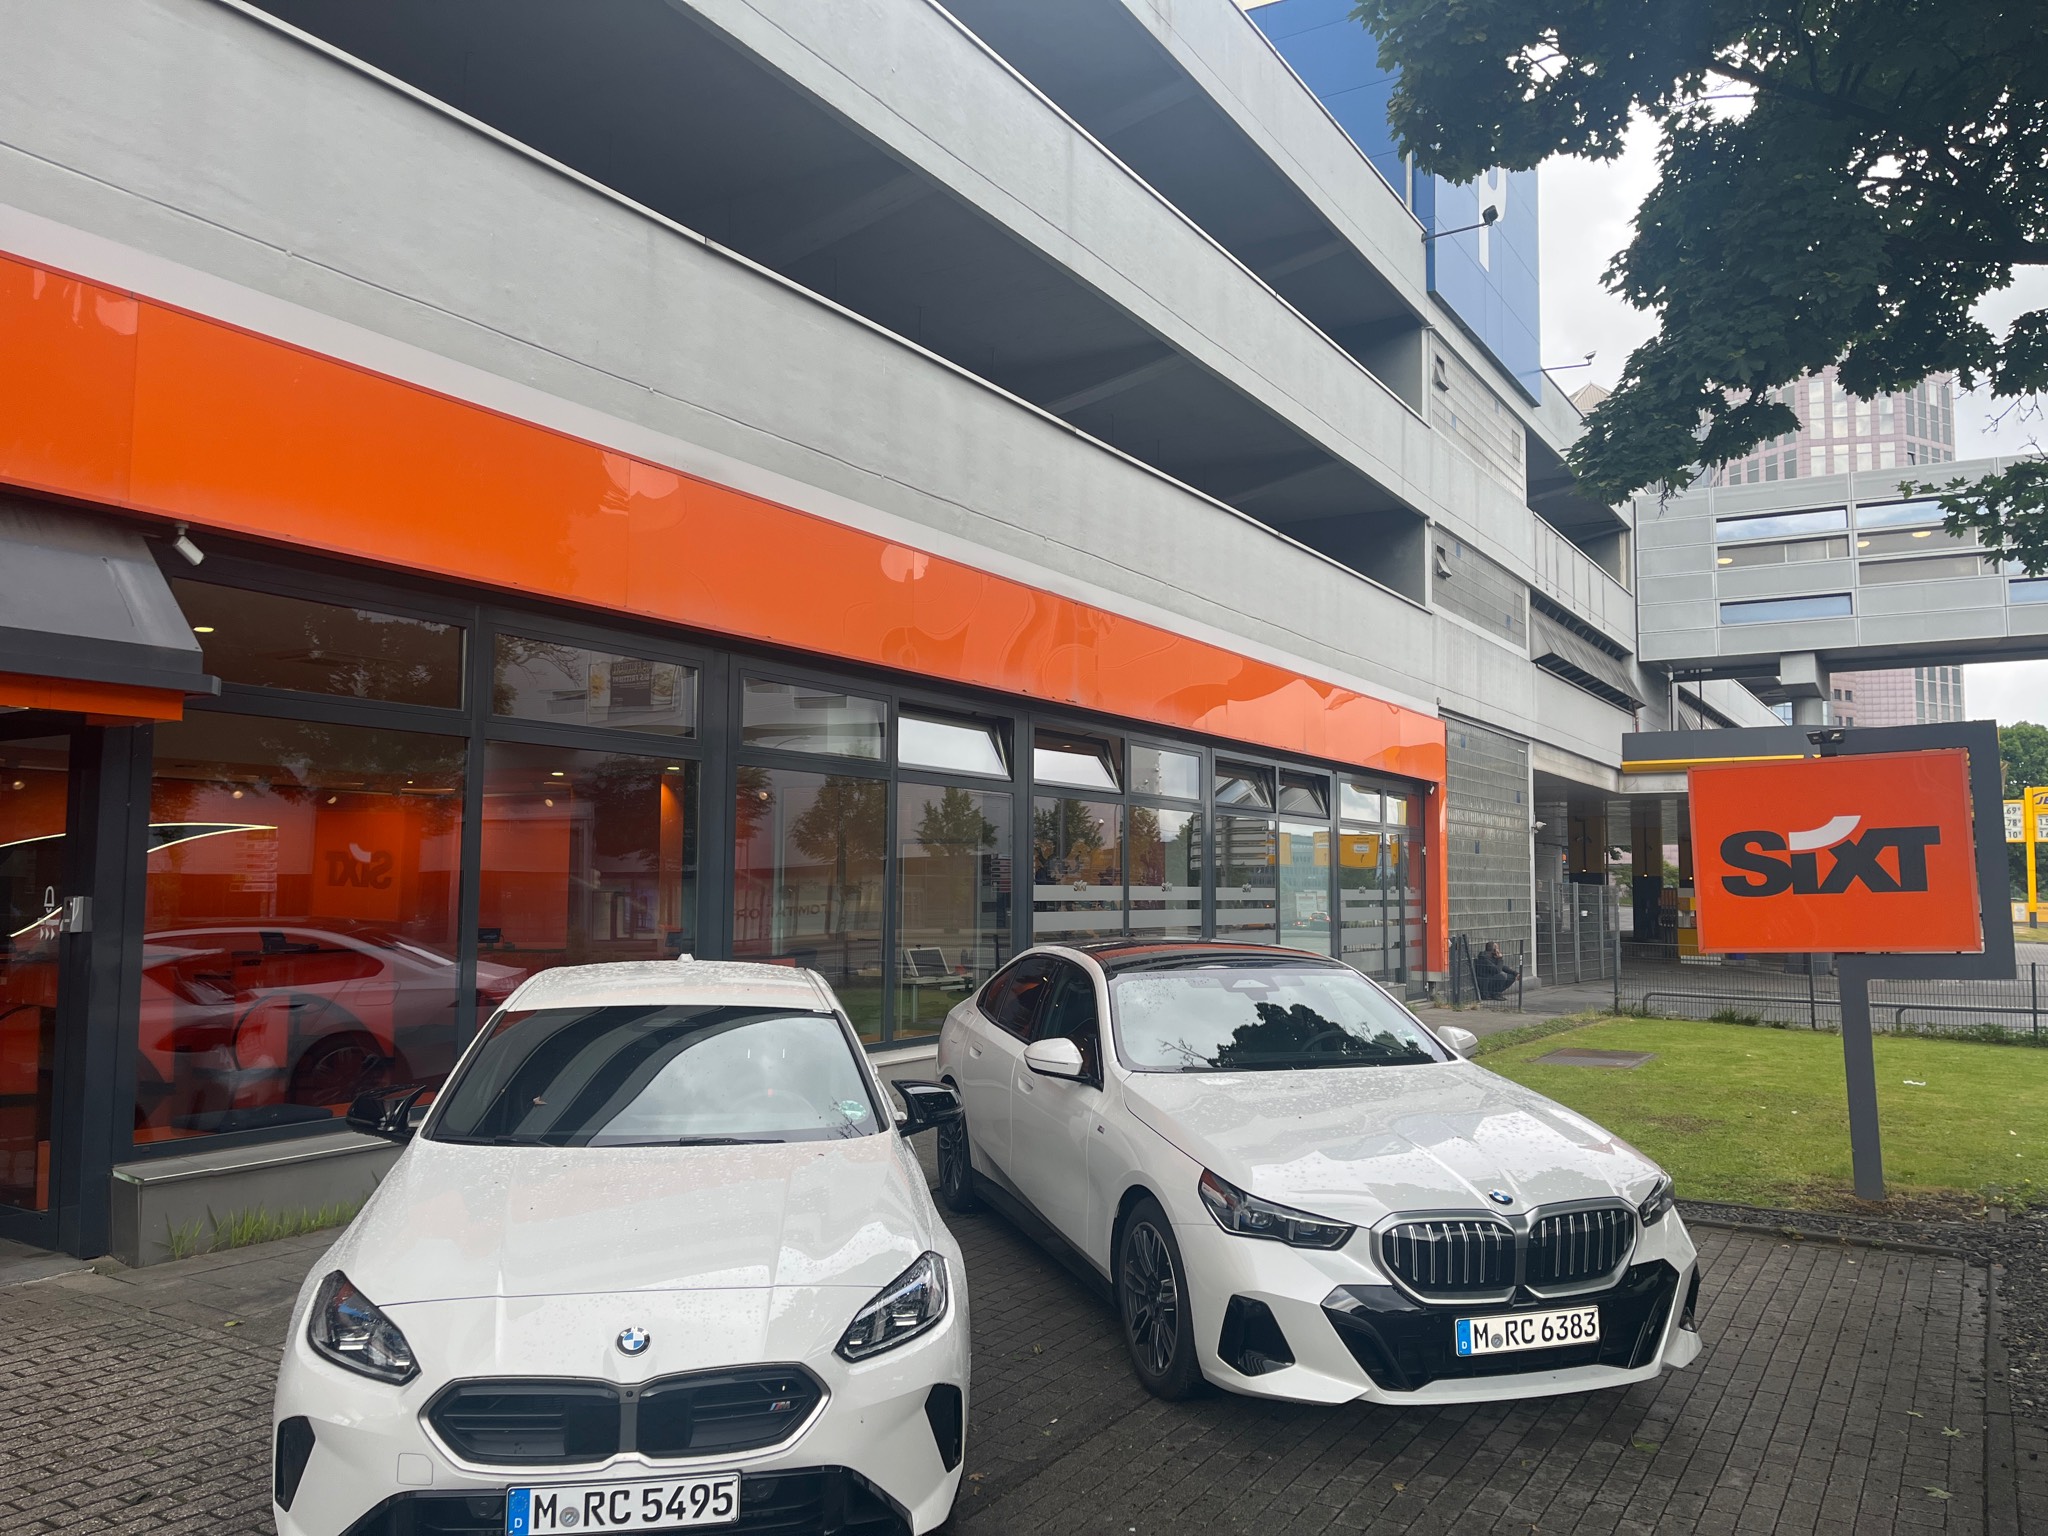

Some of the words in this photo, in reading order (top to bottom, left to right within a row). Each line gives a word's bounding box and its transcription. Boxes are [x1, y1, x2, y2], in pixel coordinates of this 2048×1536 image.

[1473, 1322, 1489, 1349] M
[1505, 1319, 1535, 1346] RC
[1541, 1311, 1597, 1342] 6383
[514, 1517, 523, 1529] D
[533, 1493, 558, 1530] M
[583, 1489, 632, 1527] RC
[641, 1481, 735, 1523] 5495
